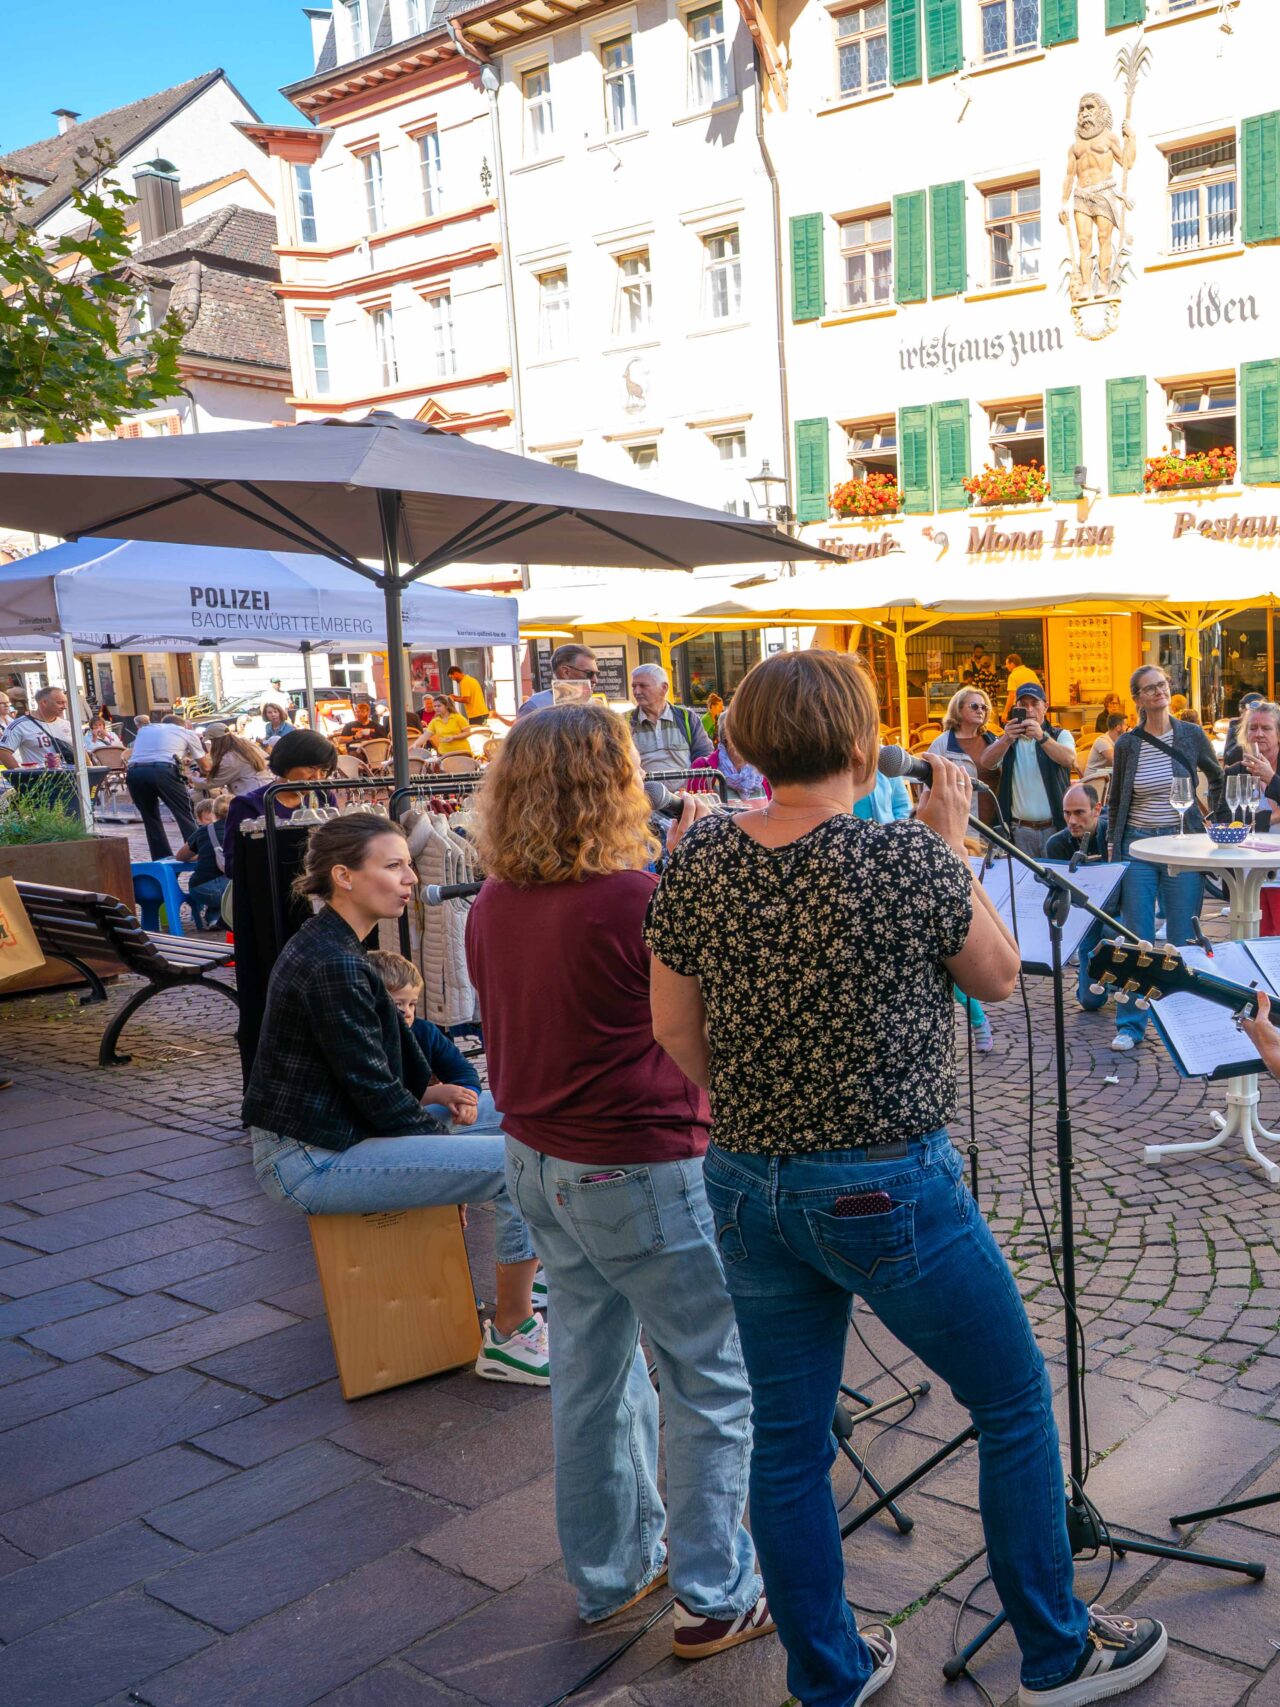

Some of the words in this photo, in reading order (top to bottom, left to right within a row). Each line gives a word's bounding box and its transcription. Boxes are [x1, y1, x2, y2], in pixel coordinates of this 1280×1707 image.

[965, 524, 1043, 555] Mona
[1052, 519, 1114, 549] Lisa
[189, 586, 270, 611] POLIZEI
[191, 612, 373, 633] BADEN-WÜRTTEMBERG
[36, 736, 52, 748] 19
